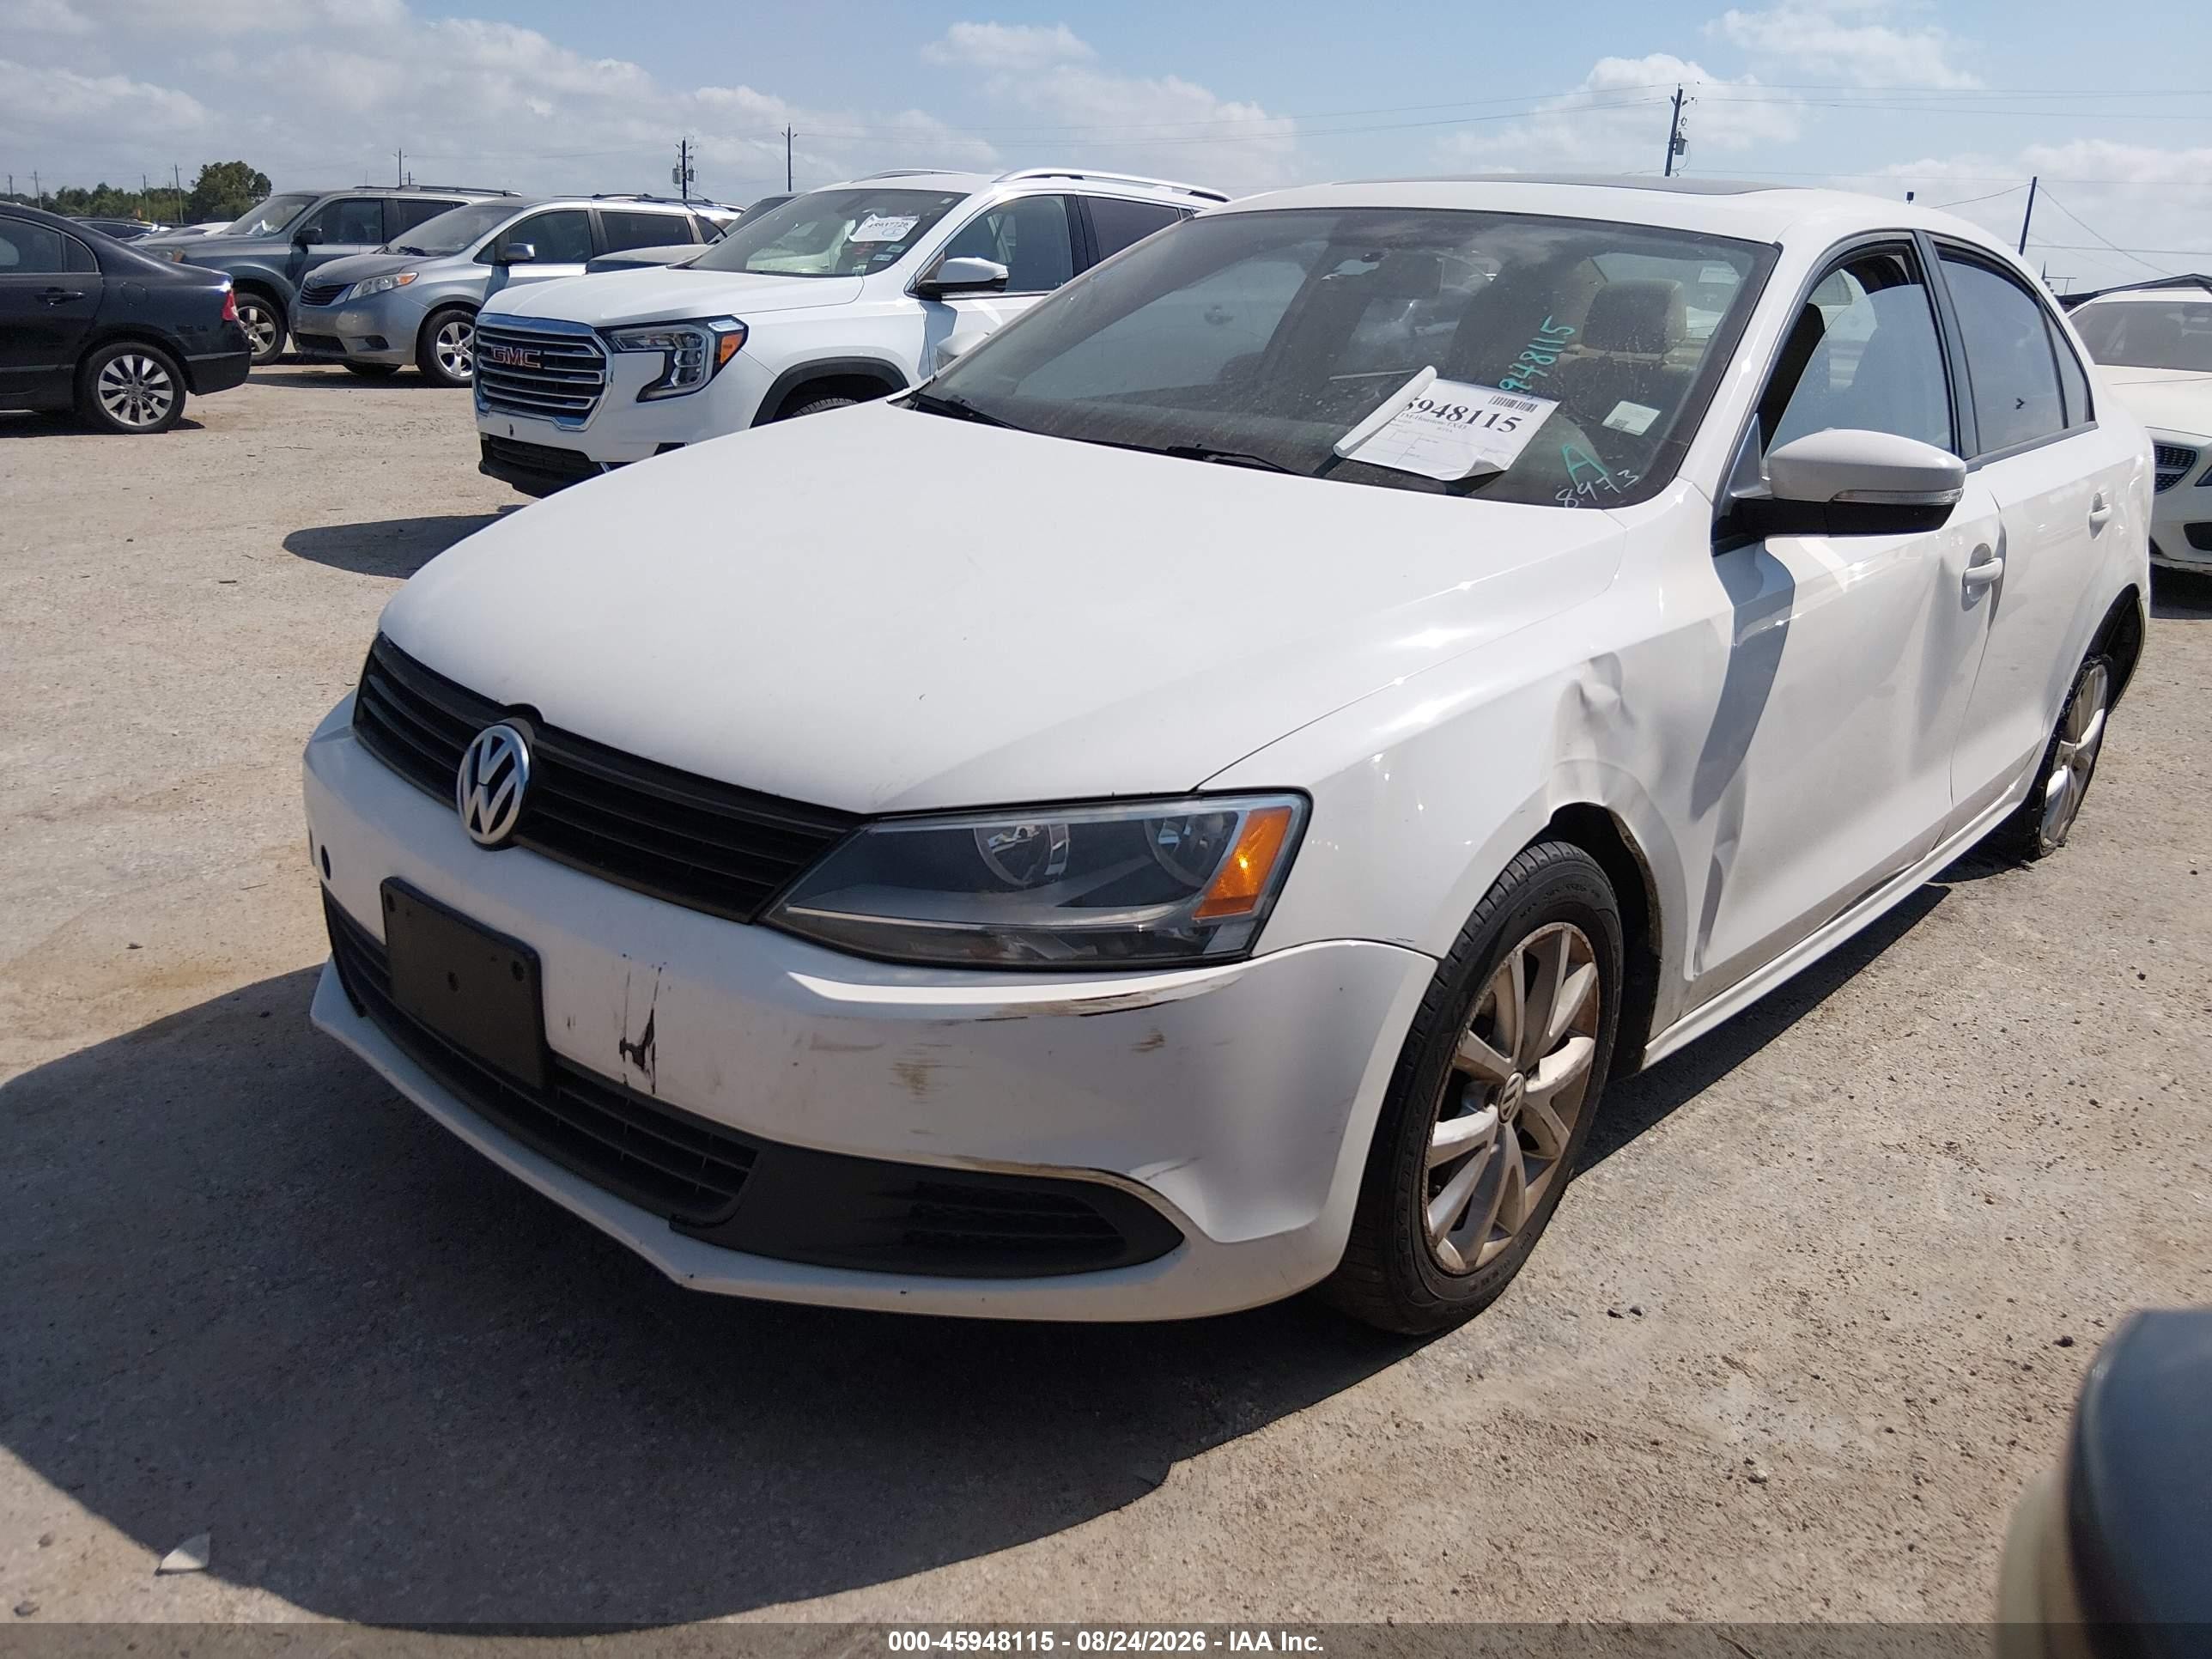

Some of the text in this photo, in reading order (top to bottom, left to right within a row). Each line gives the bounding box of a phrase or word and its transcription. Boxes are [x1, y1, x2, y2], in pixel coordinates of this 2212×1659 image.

[490, 344, 542, 369] GMC
[1498, 314, 1576, 390] 948115
[1561, 442, 1608, 488] A
[460, 727, 525, 840] VW
[1498, 1073, 1524, 1121] VW
